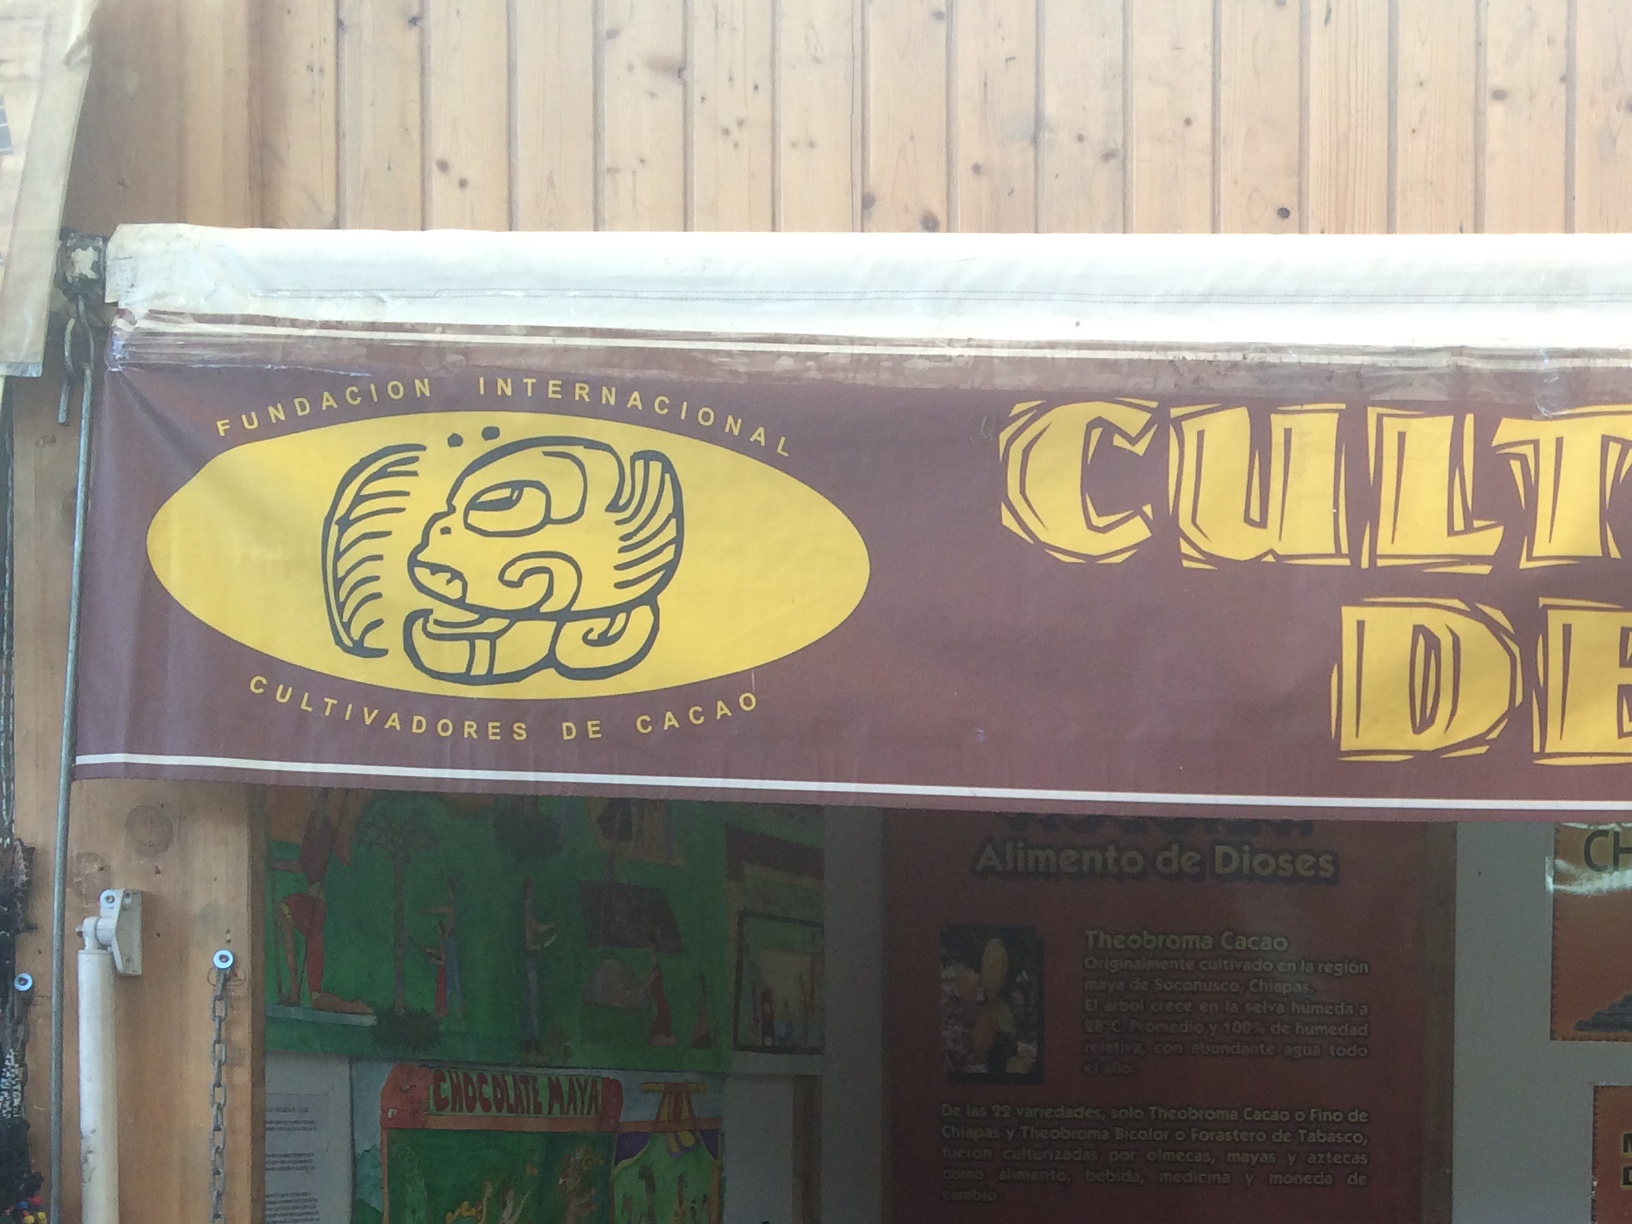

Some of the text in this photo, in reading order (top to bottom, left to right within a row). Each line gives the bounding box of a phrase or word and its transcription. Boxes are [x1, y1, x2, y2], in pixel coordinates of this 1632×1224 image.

[217, 375, 791, 458] FUNDACION INTERNACIONAL
[250, 675, 759, 742] CULTIVADORES DE CACAO
[975, 841, 1335, 878] Alimento de Dioses
[1085, 930, 1289, 951] Theobroma Cacao
[1085, 958, 1195, 975] Originalmente
[1199, 959, 1273, 973] cultivado
[1318, 960, 1368, 976] región
[434, 1070, 598, 1115] CHOCOLATE MAYA
[1148, 1107, 1238, 1121] Theobroma
[1243, 1109, 1289, 1122] Cacao
[1310, 1109, 1343, 1122] Fino
[1348, 1109, 1368, 1122] de
[1020, 1127, 1109, 1140] Theobroma
[1115, 1128, 1169, 1141] Bicolor
[1191, 1129, 1266, 1143] Forastero
[1271, 1130, 1292, 1143] de
[1298, 1130, 1368, 1146] Tabasco,
[1227, 1152, 1276, 1166] mayas
[1307, 1152, 1367, 1165] aztecas
